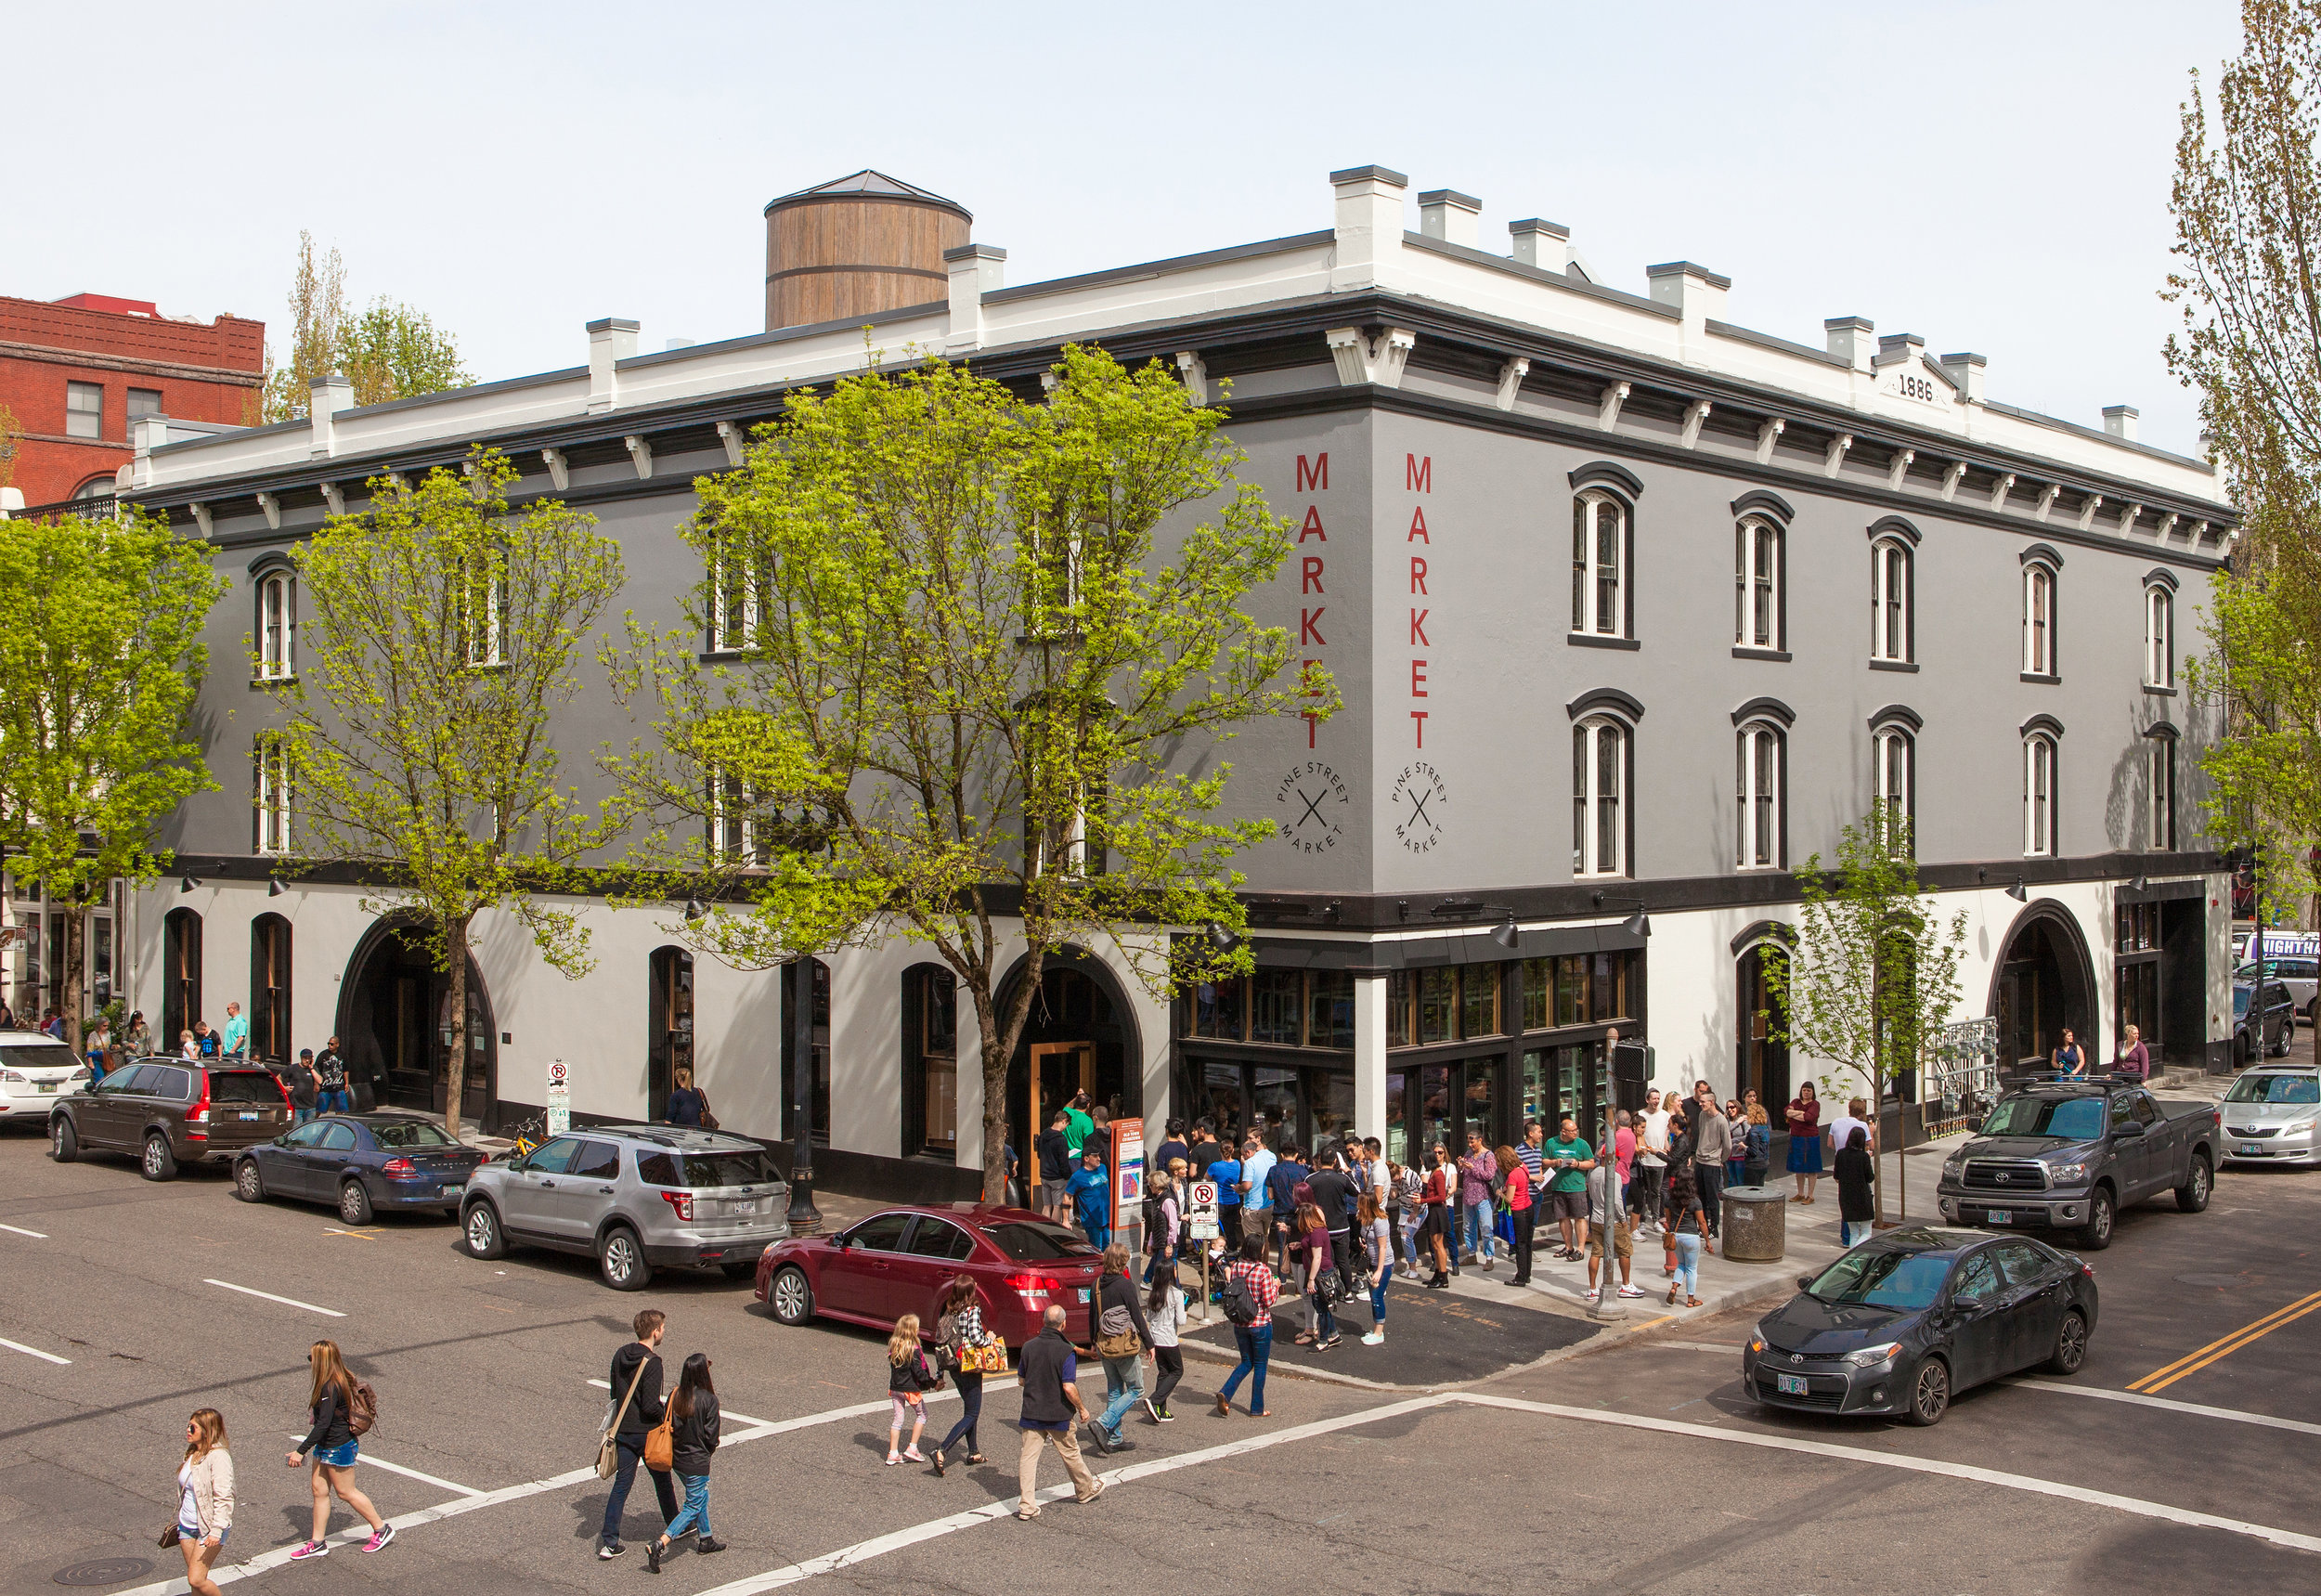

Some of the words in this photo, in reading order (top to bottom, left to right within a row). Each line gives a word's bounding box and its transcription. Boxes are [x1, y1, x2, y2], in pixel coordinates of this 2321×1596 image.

[1900, 374, 1932, 402] 1886
[1407, 453, 1431, 748] MARKET
[1277, 766, 1302, 802] PINE
[1307, 761, 1348, 804] STREET
[1392, 766, 1411, 802] PINE
[1415, 761, 1446, 803] STREET
[1281, 824, 1342, 854] MARKET
[1395, 824, 1443, 854] MARKET
